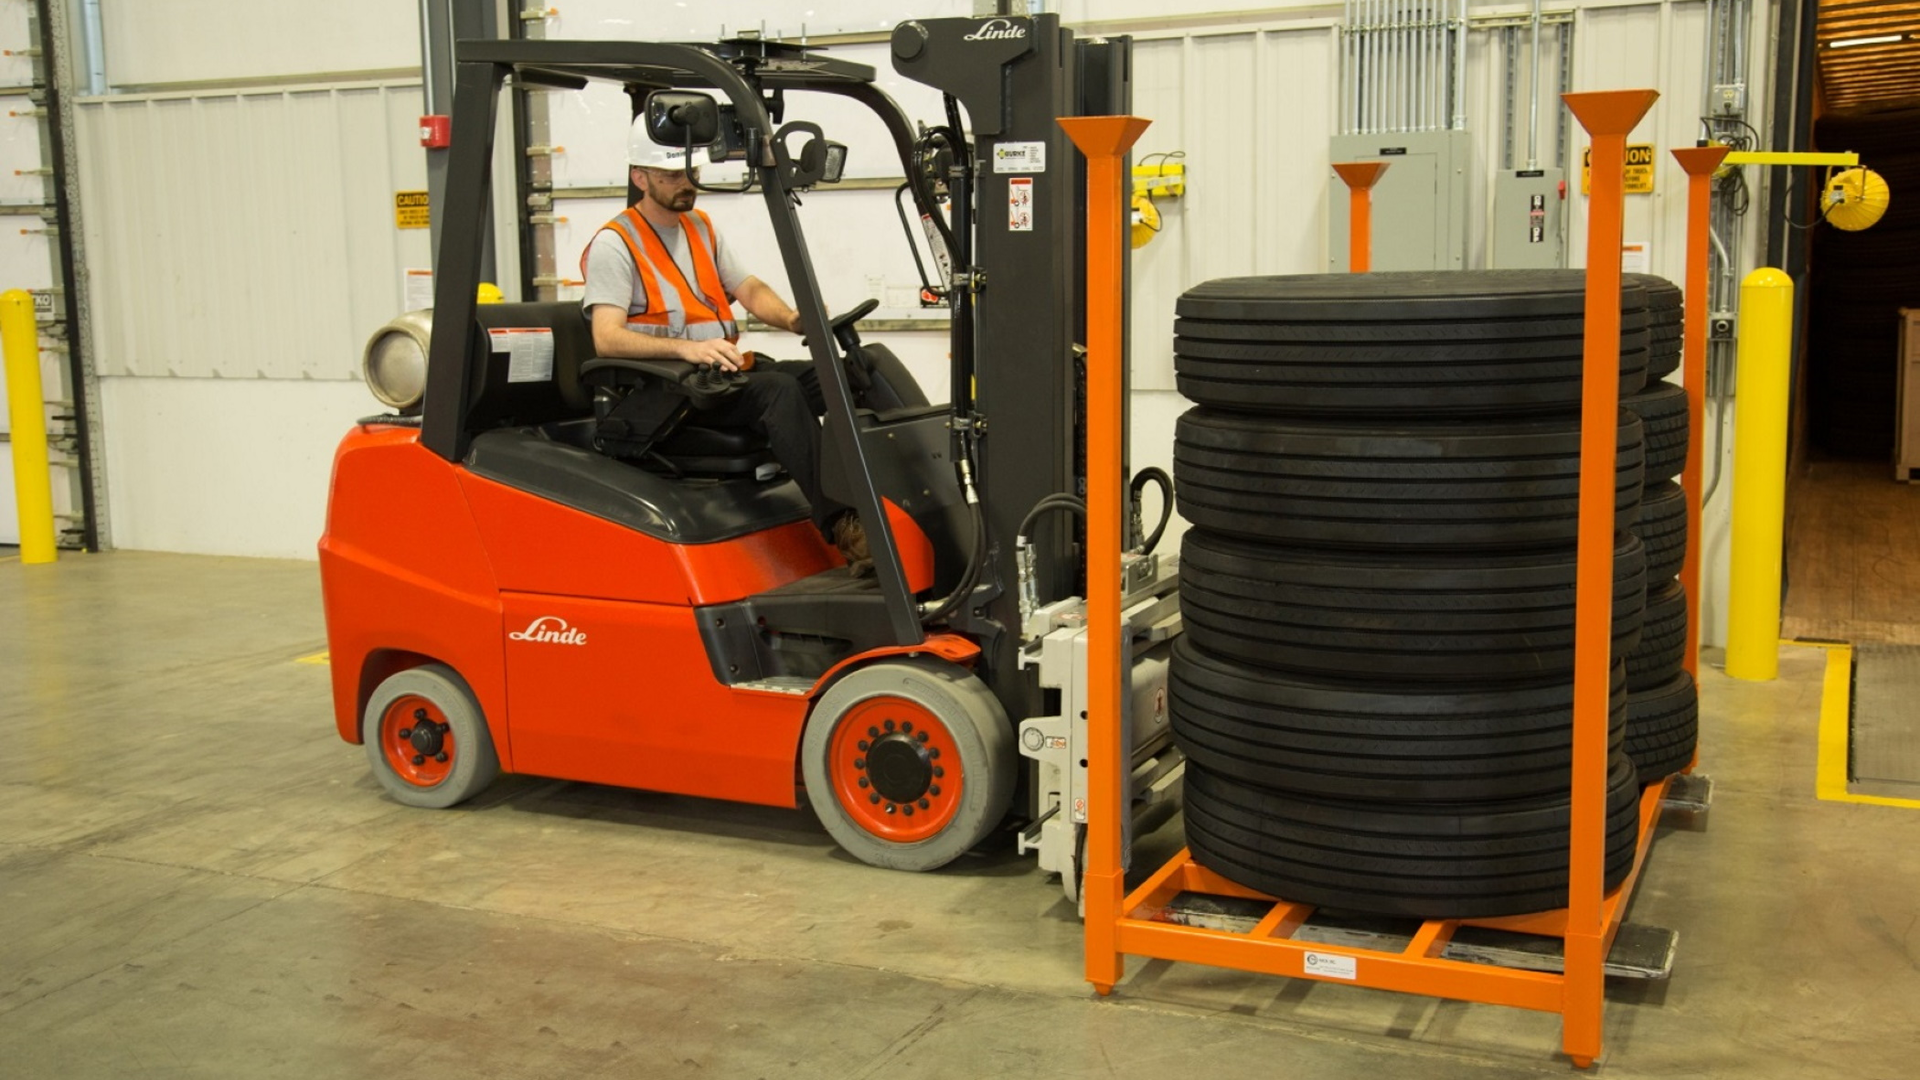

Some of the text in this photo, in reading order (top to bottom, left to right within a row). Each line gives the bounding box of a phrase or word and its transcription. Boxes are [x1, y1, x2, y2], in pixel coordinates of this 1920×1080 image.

[963, 19, 1026, 41] Linde
[398, 195, 429, 206] CAUTIO
[508, 615, 587, 646] Linde
